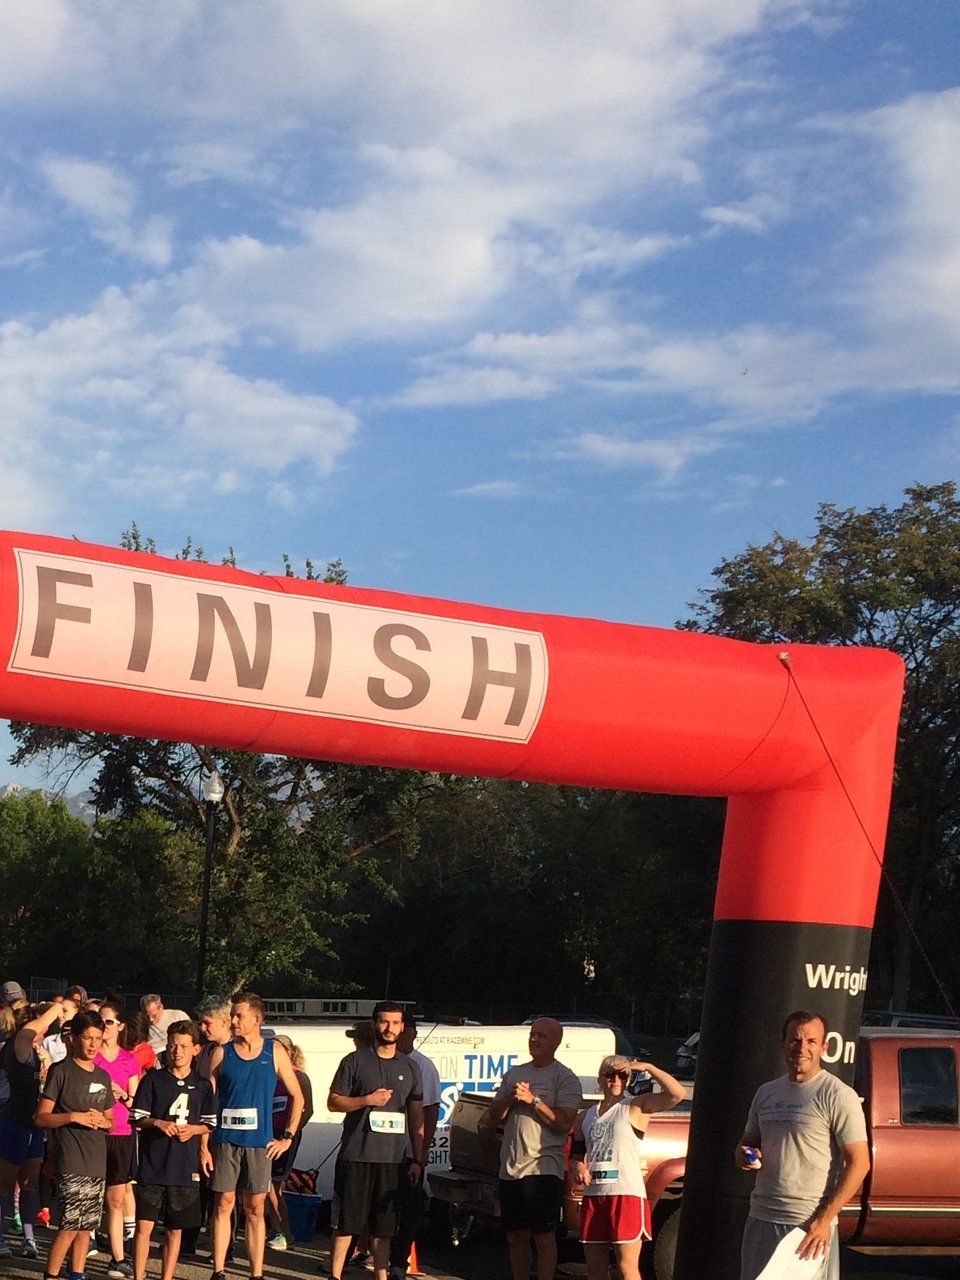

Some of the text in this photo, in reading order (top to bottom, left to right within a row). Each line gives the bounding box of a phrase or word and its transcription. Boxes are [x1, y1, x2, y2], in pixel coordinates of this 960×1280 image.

[30, 565, 532, 727] FINISH
[805, 963, 868, 996] Wrigh
[820, 1031, 856, 1064] On
[169, 1092, 190, 1125] 4
